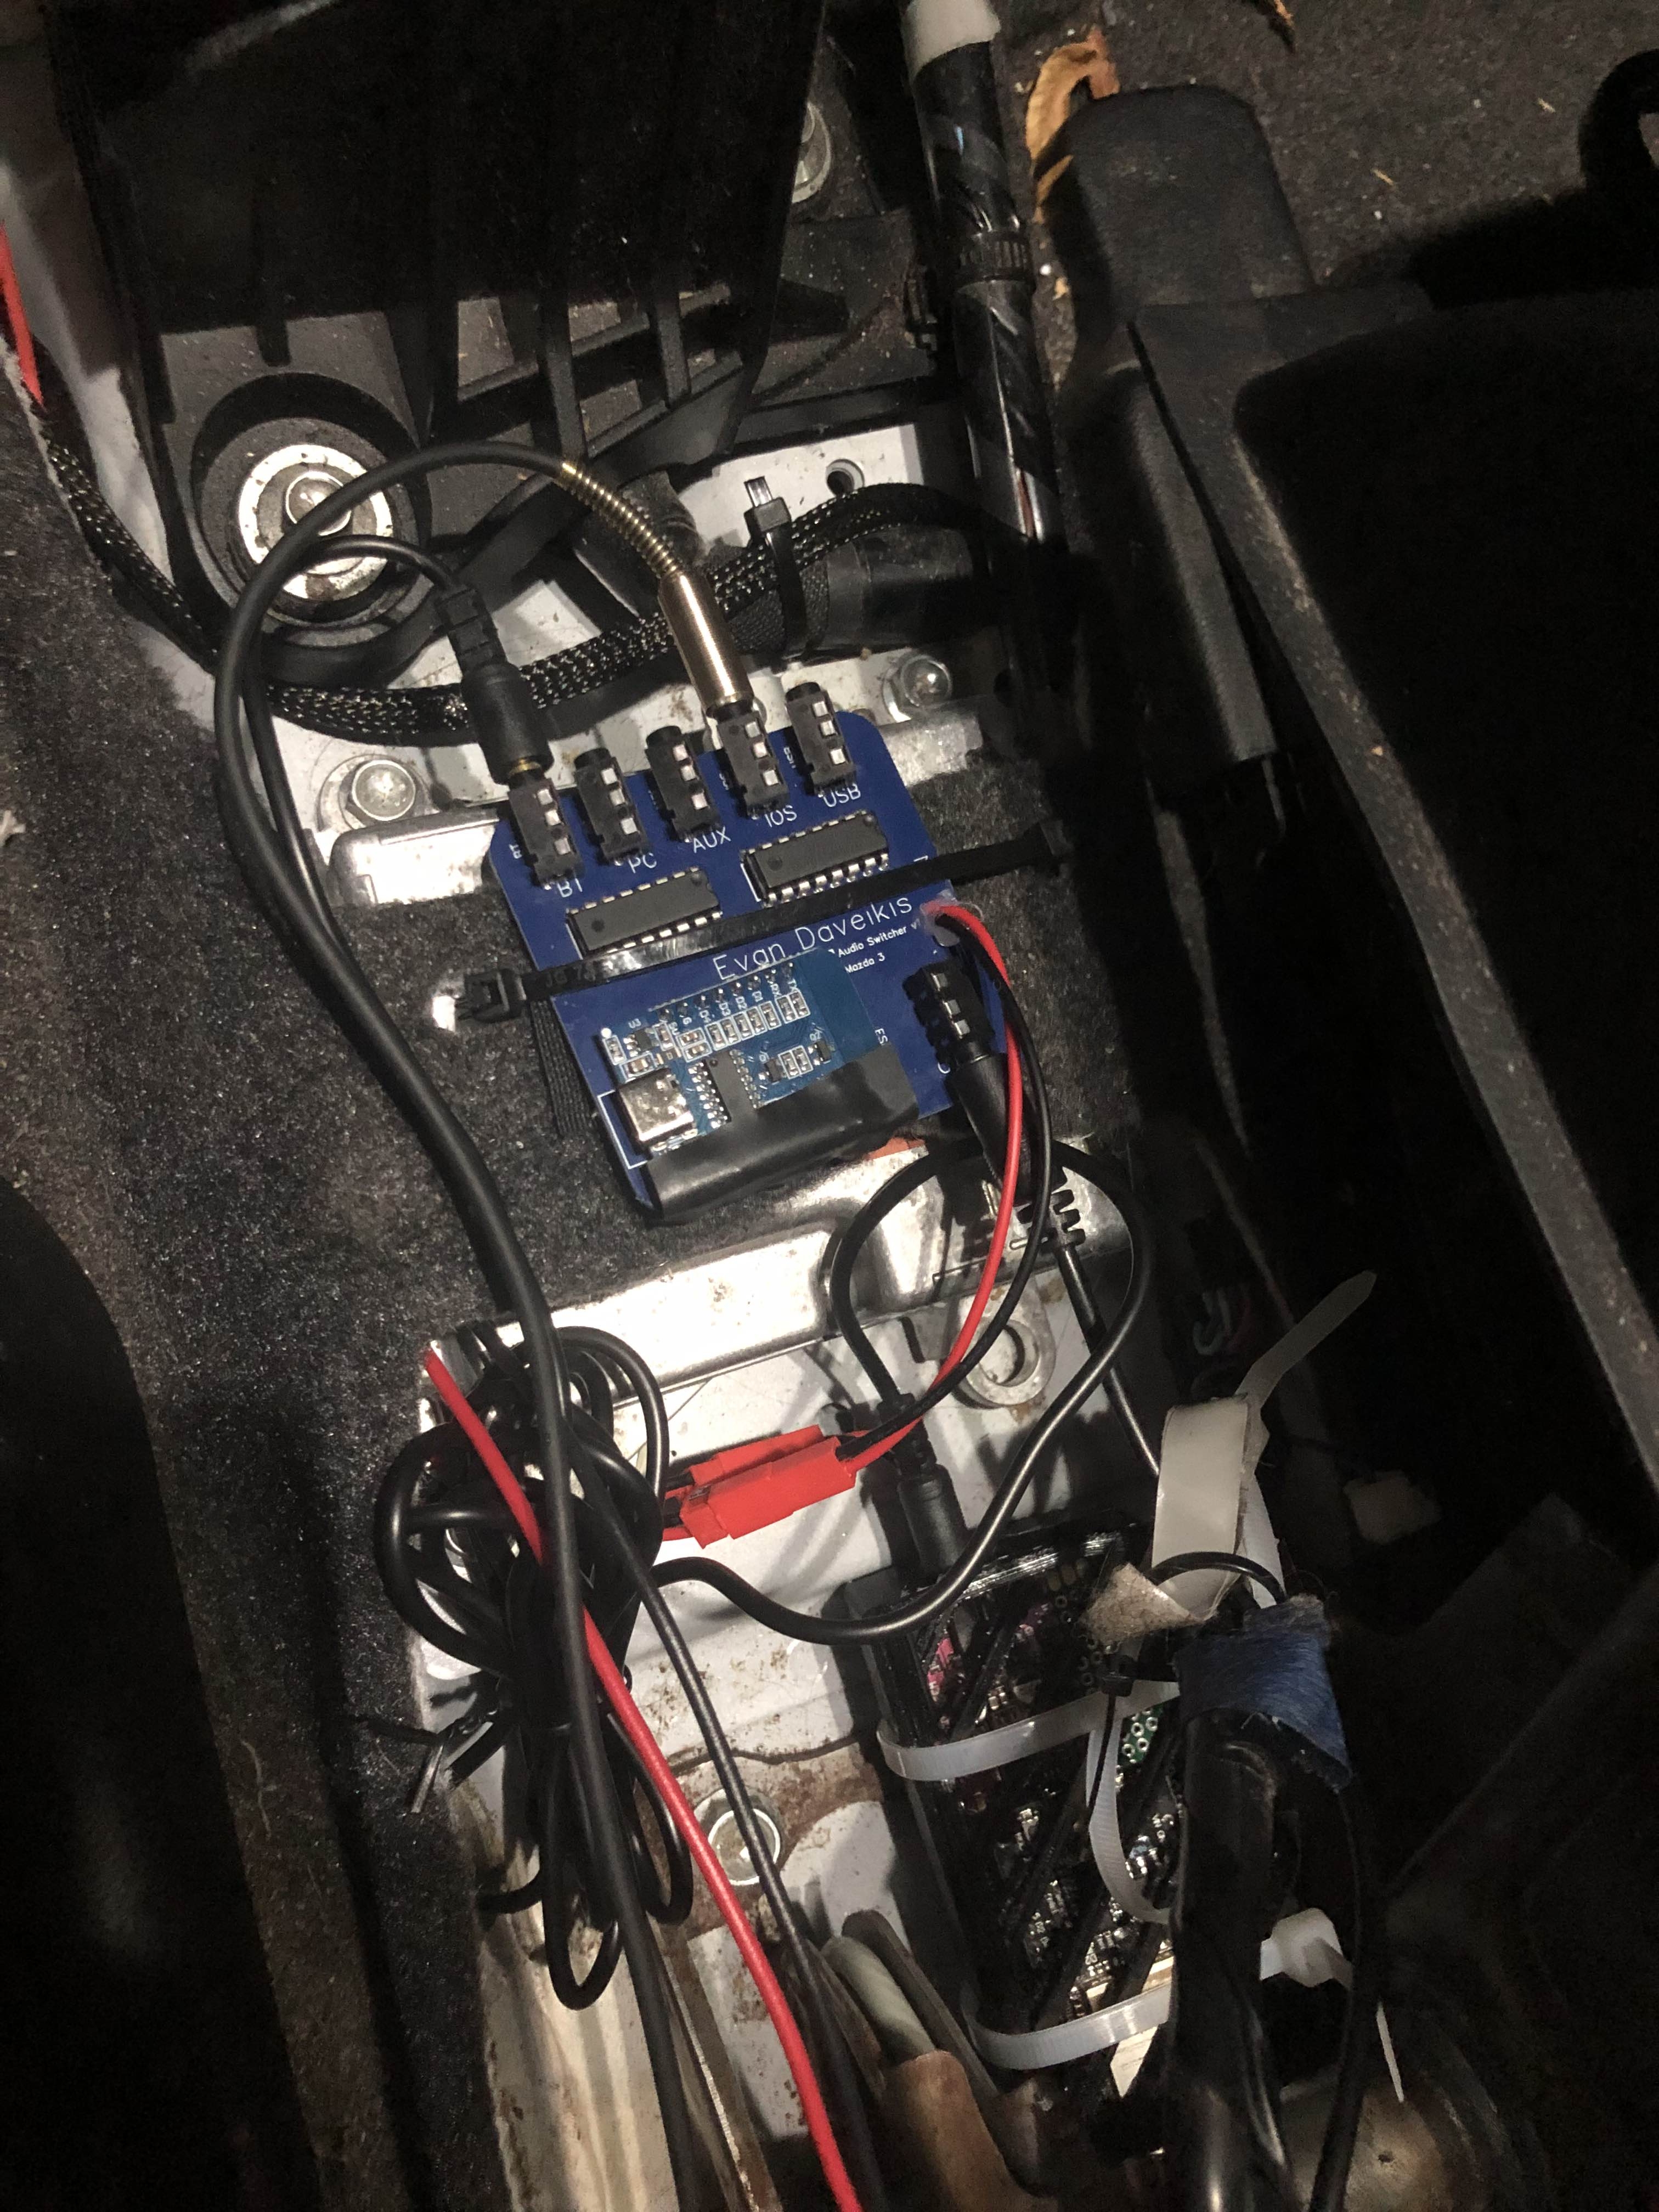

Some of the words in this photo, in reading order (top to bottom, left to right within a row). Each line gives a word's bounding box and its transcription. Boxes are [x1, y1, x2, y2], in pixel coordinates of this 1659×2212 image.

[823, 783, 861, 807] USB
[765, 805, 797, 827] IOS
[693, 827, 731, 853] AUX
[627, 853, 657, 873] PC
[713, 943, 786, 980] Evan
[795, 898, 912, 951] Daveikis
[838, 943, 864, 957] Audio
[867, 926, 907, 946] Switcher
[845, 958, 875, 973] Mazda
[877, 952, 885, 961] 3
